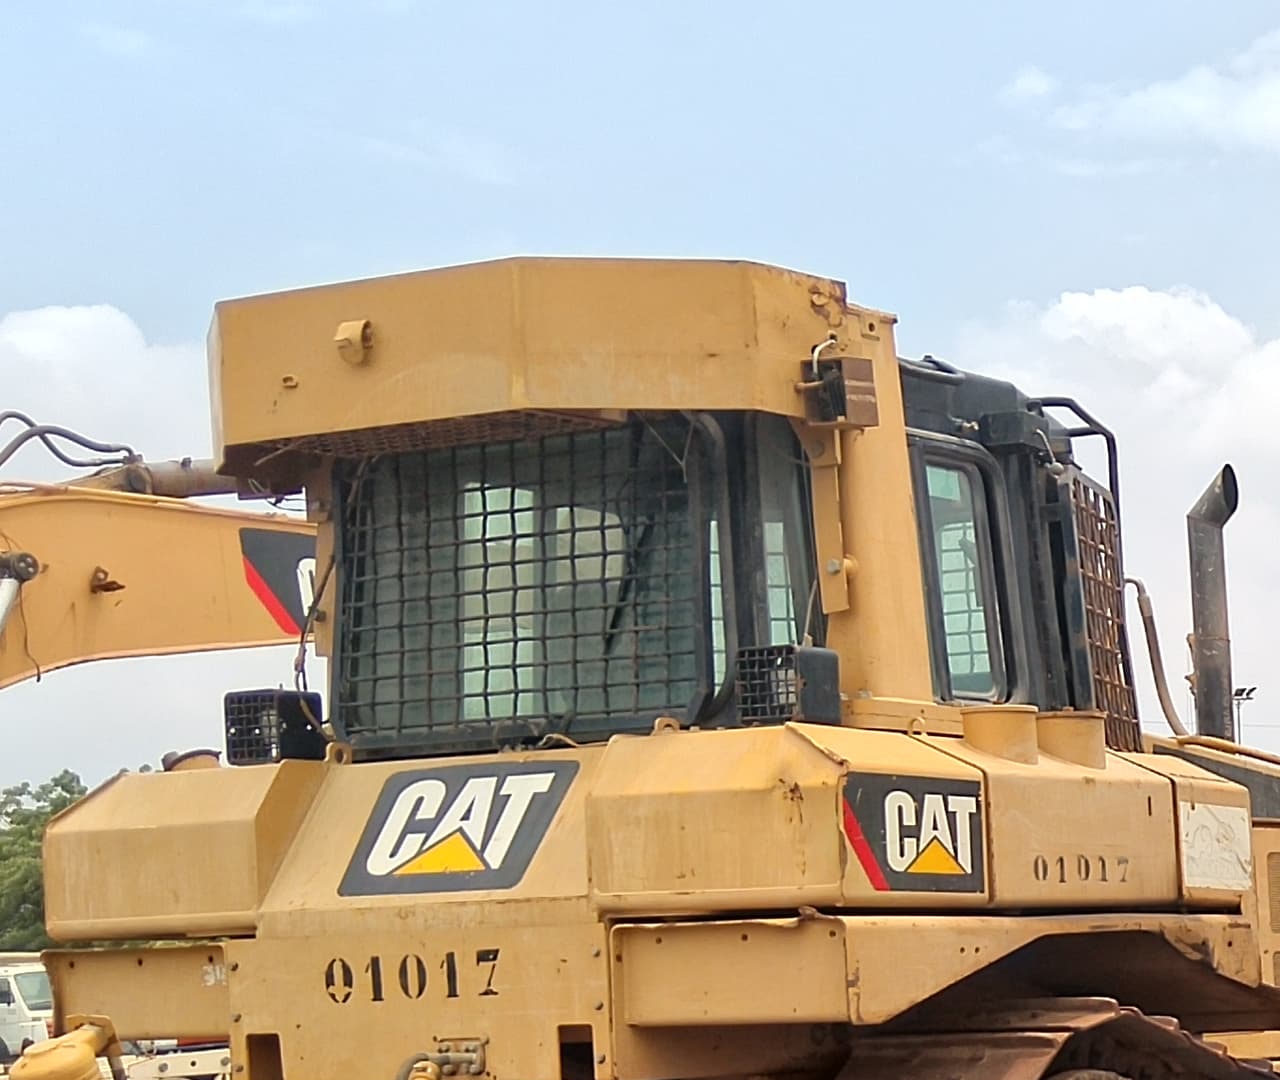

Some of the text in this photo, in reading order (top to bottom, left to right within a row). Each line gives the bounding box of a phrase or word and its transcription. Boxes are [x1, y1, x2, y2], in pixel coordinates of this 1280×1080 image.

[366, 772, 556, 877] CAT
[884, 789, 977, 875] CAT
[1033, 853, 1129, 884] 01017
[325, 948, 500, 1003] 01017
